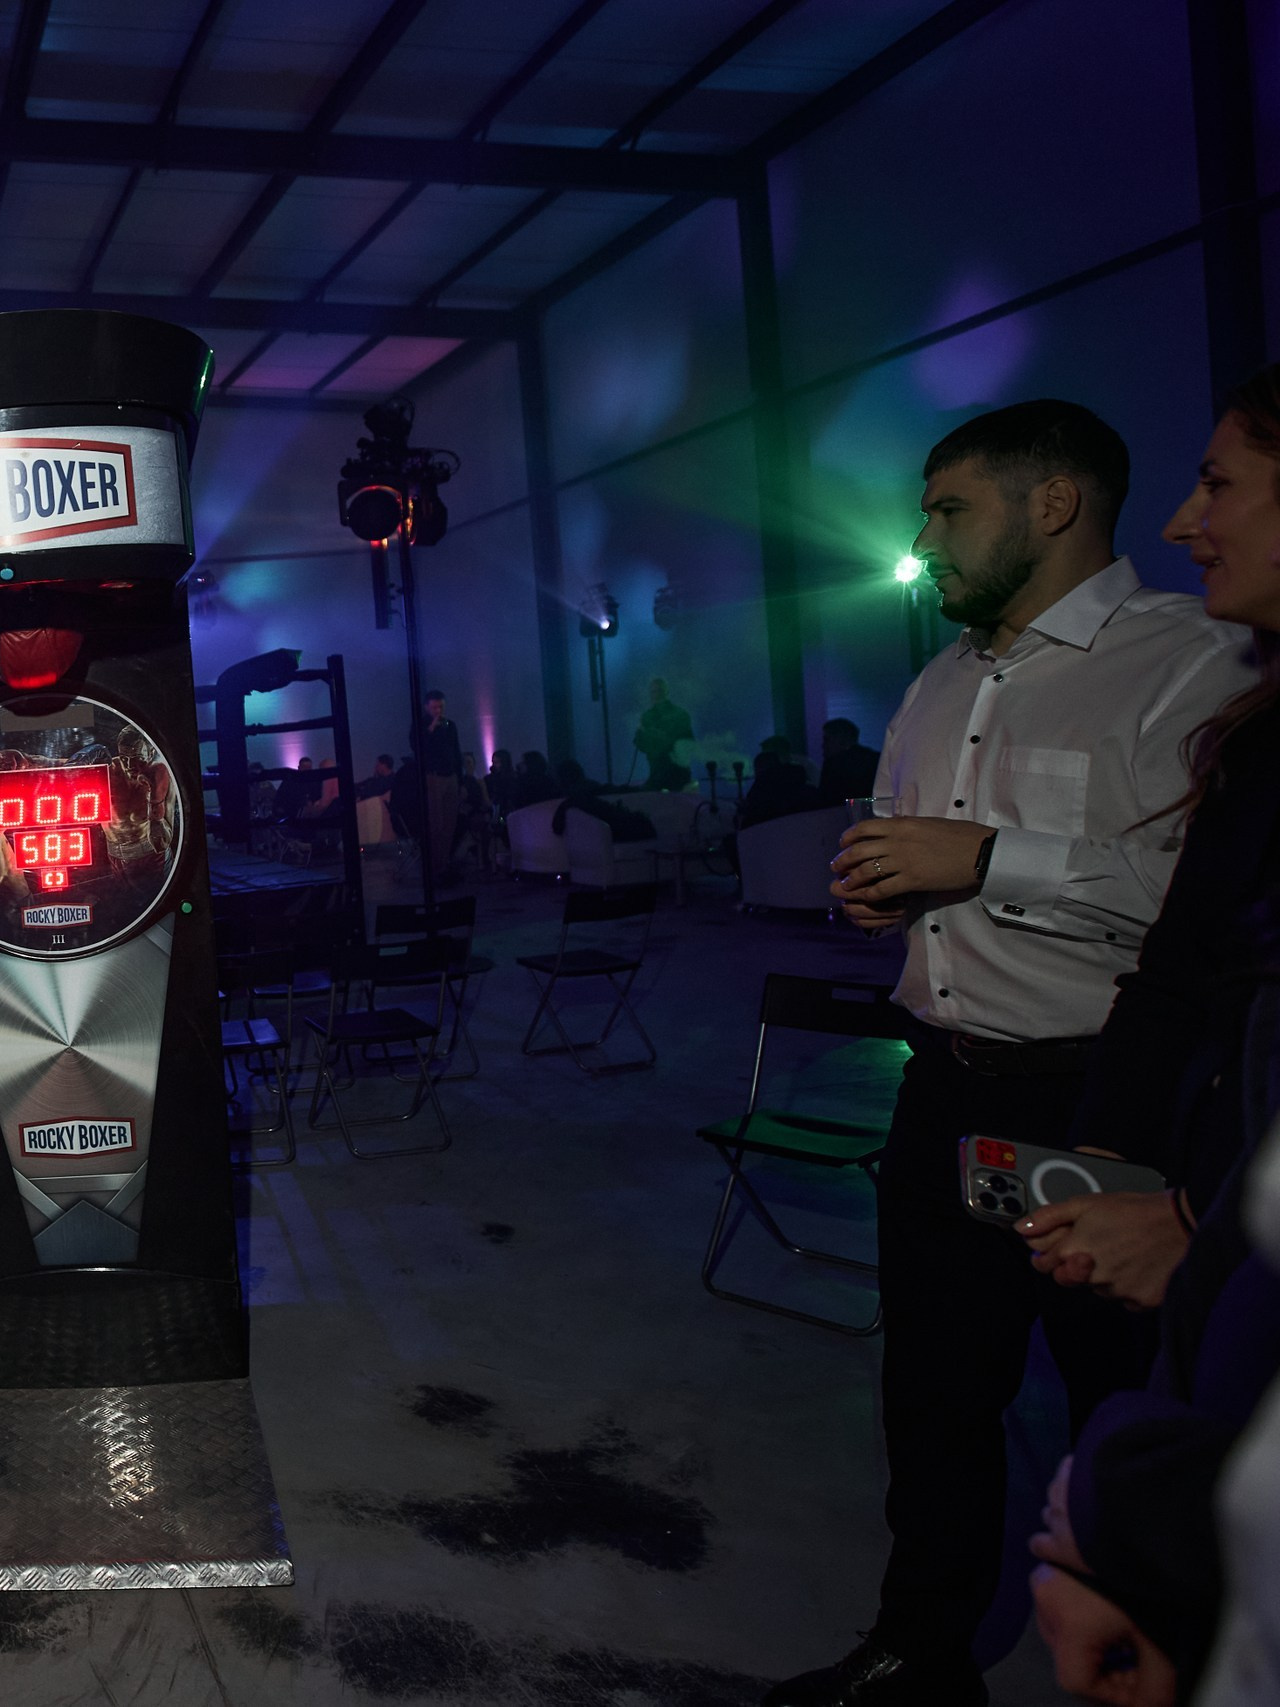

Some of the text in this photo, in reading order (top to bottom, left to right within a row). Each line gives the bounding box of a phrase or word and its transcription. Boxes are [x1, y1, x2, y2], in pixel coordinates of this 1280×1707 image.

[6, 459, 120, 523] BOXER
[22, 832, 84, 864] 583
[26, 907, 88, 924] ROCKY BOXER
[52, 934, 65, 945] III
[27, 1124, 128, 1150] ROCKY BOXER
